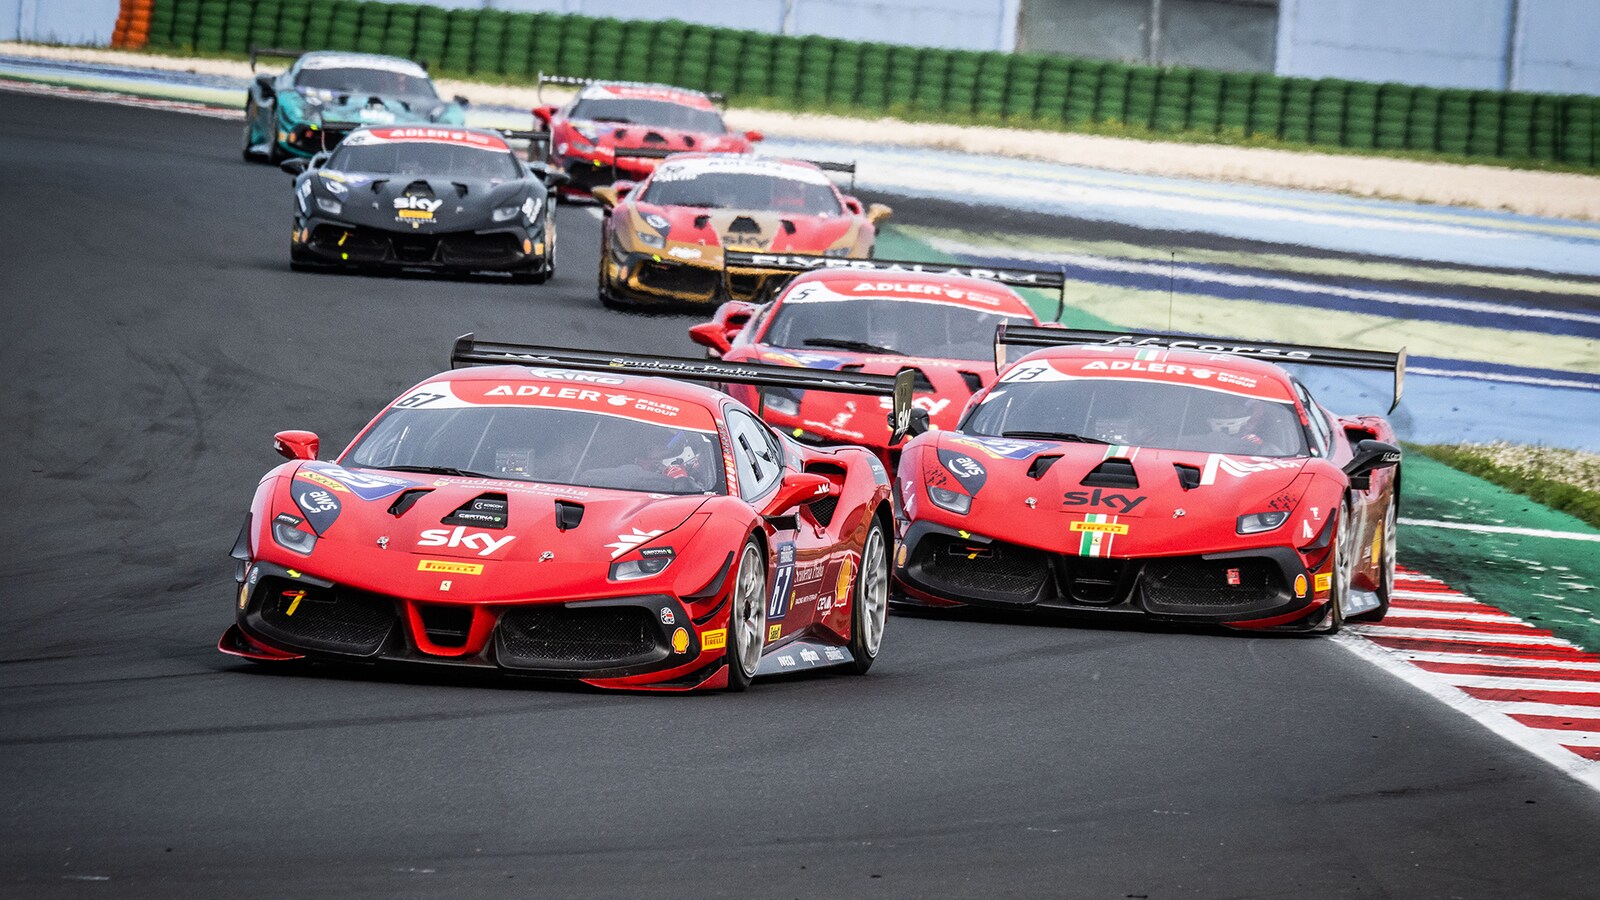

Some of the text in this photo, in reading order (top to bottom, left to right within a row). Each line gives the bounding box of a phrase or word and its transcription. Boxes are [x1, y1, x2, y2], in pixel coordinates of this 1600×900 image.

[389, 128, 449, 138] ADLER
[394, 196, 443, 212] sky
[791, 288, 815, 300] 5
[852, 282, 941, 295] ADLER
[610, 357, 758, 377] Scuderia Praha
[1004, 366, 1048, 381] 13
[1080, 360, 1188, 376] ADLER
[1217, 377, 1256, 389] GROUP
[1218, 371, 1257, 384] PELZER
[396, 392, 446, 408] 67
[484, 384, 601, 402] ADLER
[635, 404, 677, 417] GROUP
[637, 398, 680, 412] PELZER
[955, 457, 985, 477] aws
[437, 477, 525, 490] Scuderia
[309, 490, 338, 511] aws
[1062, 489, 1148, 513] sky
[458, 513, 493, 521] CERTINA
[1077, 523, 1122, 532] PIRELLI
[416, 526, 516, 556] sky
[425, 562, 476, 572] PIRELLI
[769, 566, 792, 616] 67
[704, 632, 724, 646] PIRELLI
[777, 655, 796, 667] IVECO
